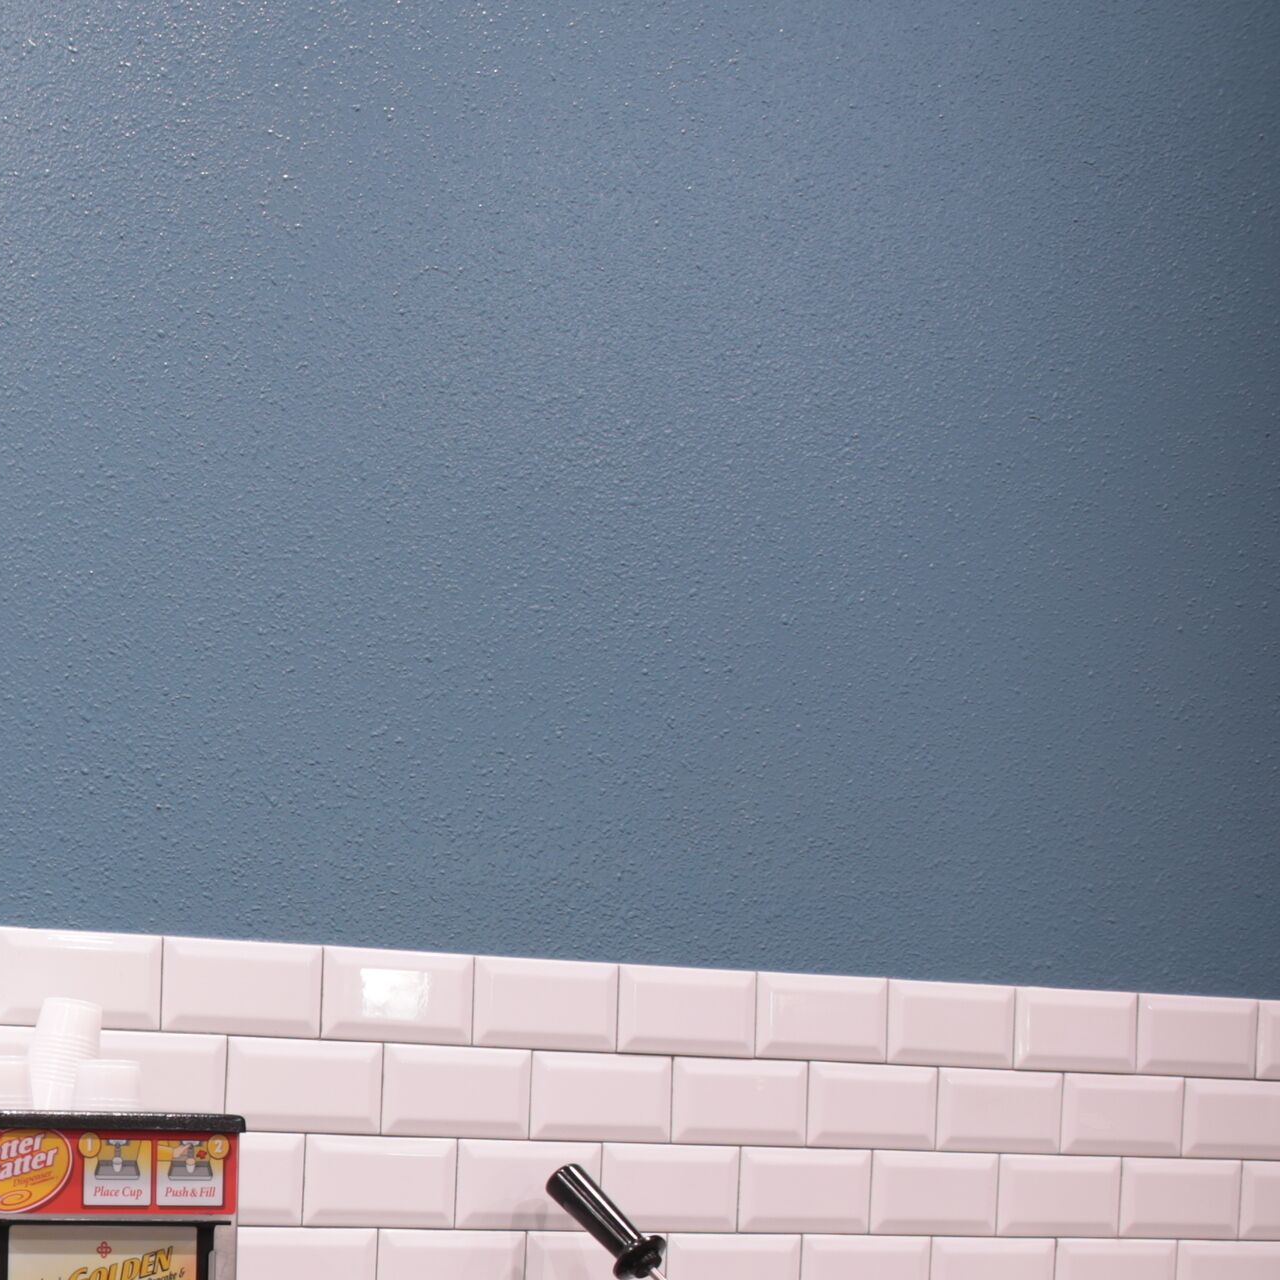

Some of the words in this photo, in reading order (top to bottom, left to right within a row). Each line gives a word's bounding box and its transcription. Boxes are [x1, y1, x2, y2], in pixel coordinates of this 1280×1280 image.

[86, 1137, 93, 1151] 1
[214, 1138, 223, 1152] 2
[13, 1170, 53, 1188] Dispenser
[93, 1186, 122, 1198] Place
[125, 1186, 143, 1199] Cup
[165, 1186, 189, 1198] Push
[190, 1187, 198, 1198] &
[199, 1186, 216, 1198] Fill
[178, 1267, 185, 1278] &
